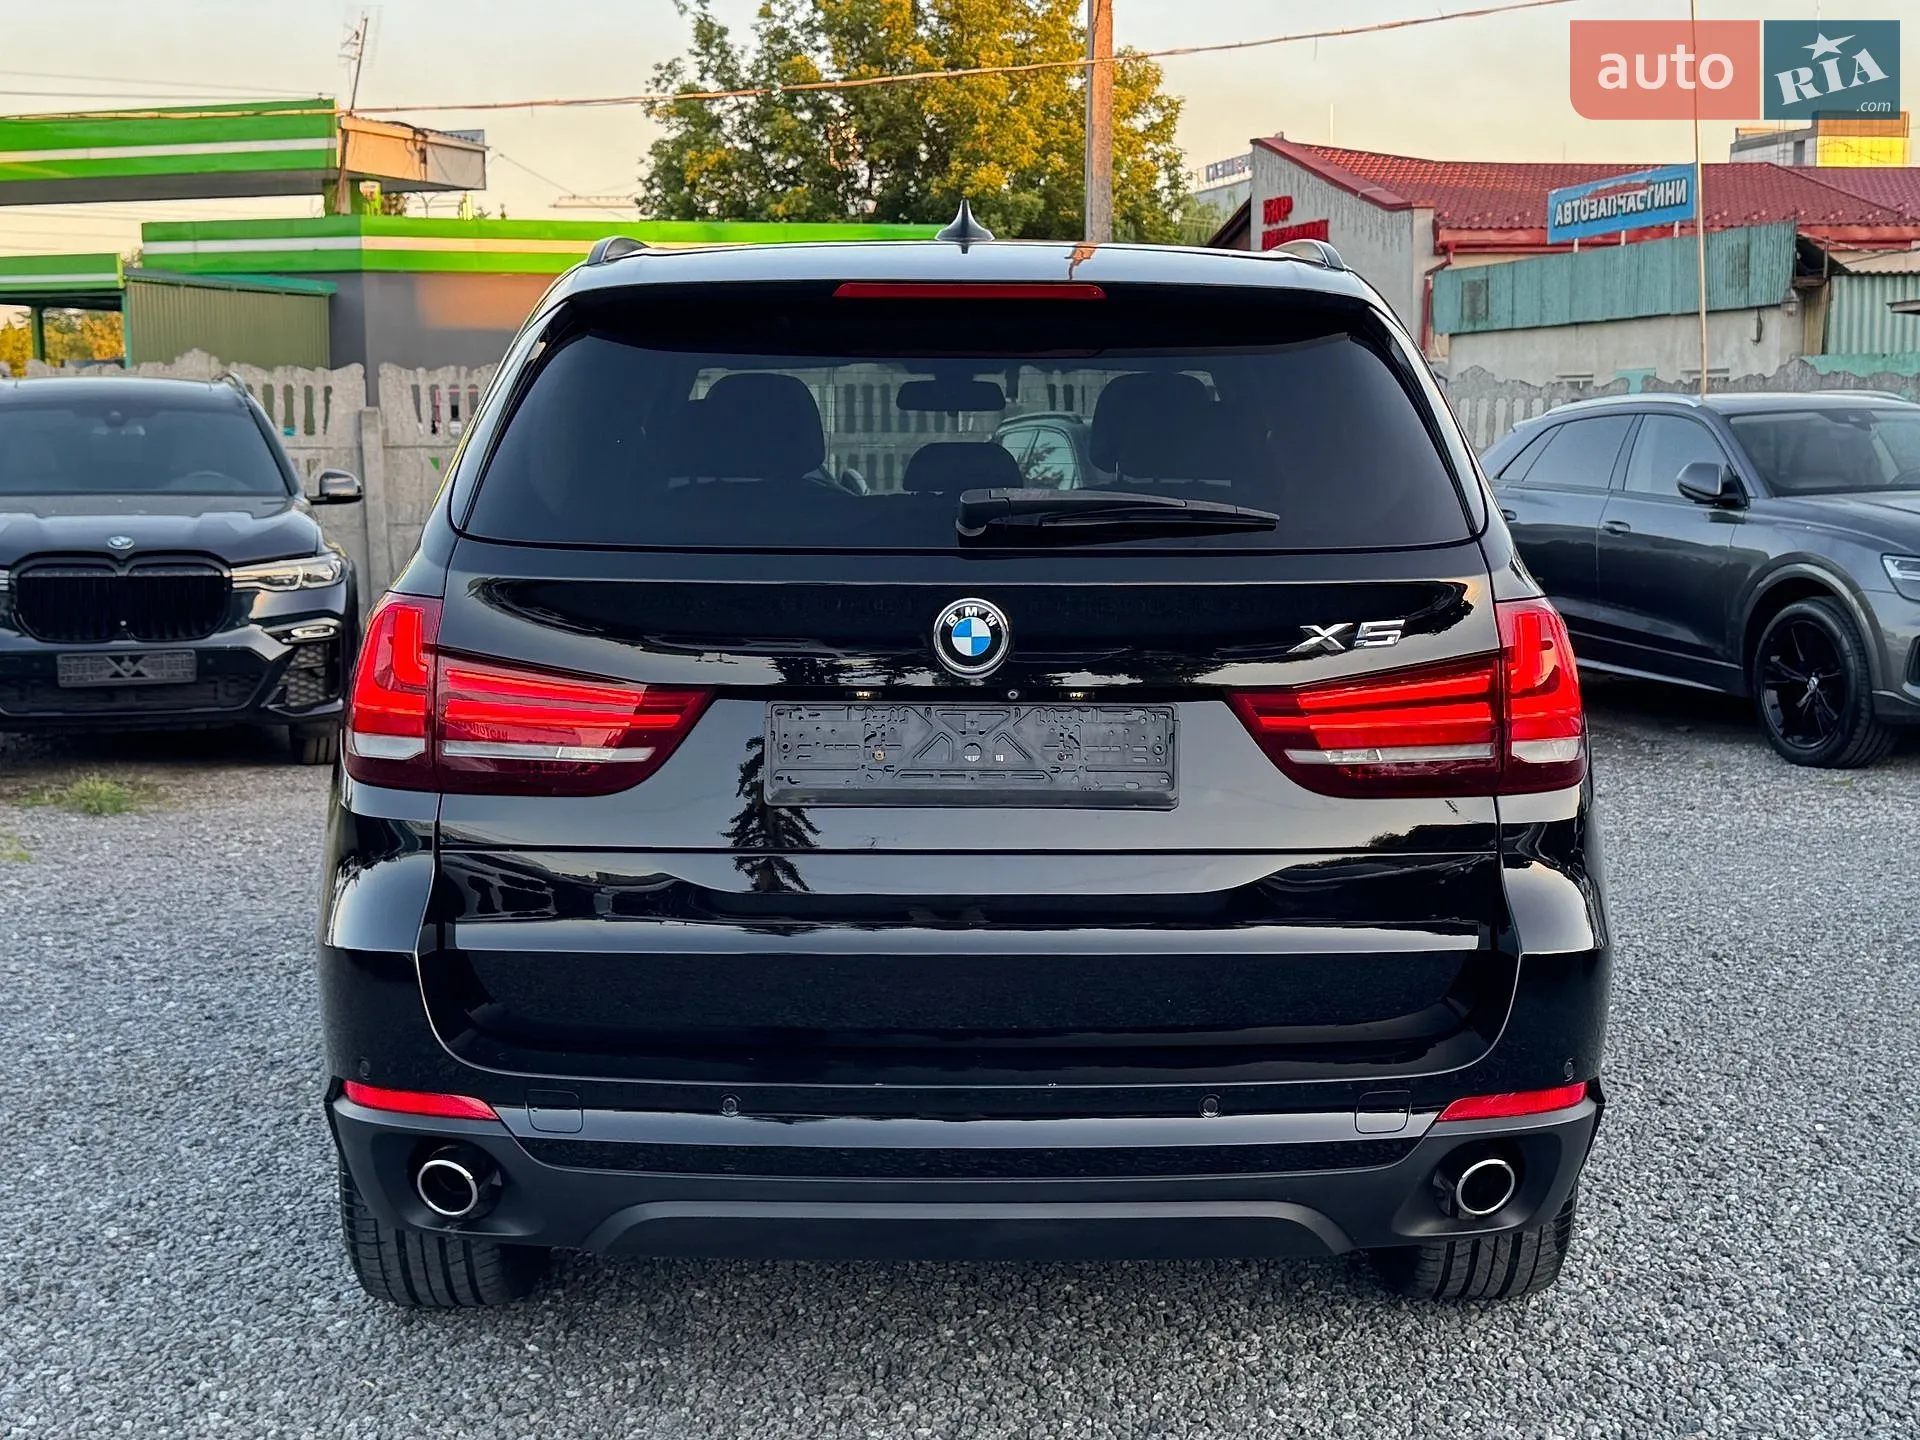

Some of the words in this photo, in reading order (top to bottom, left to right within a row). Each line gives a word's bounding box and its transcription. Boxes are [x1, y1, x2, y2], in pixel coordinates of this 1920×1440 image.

[1554, 178, 1687, 228] АВТОЗАПЧАСТИНИ
[945, 606, 997, 628] BMW
[1286, 619, 1406, 654] X5
